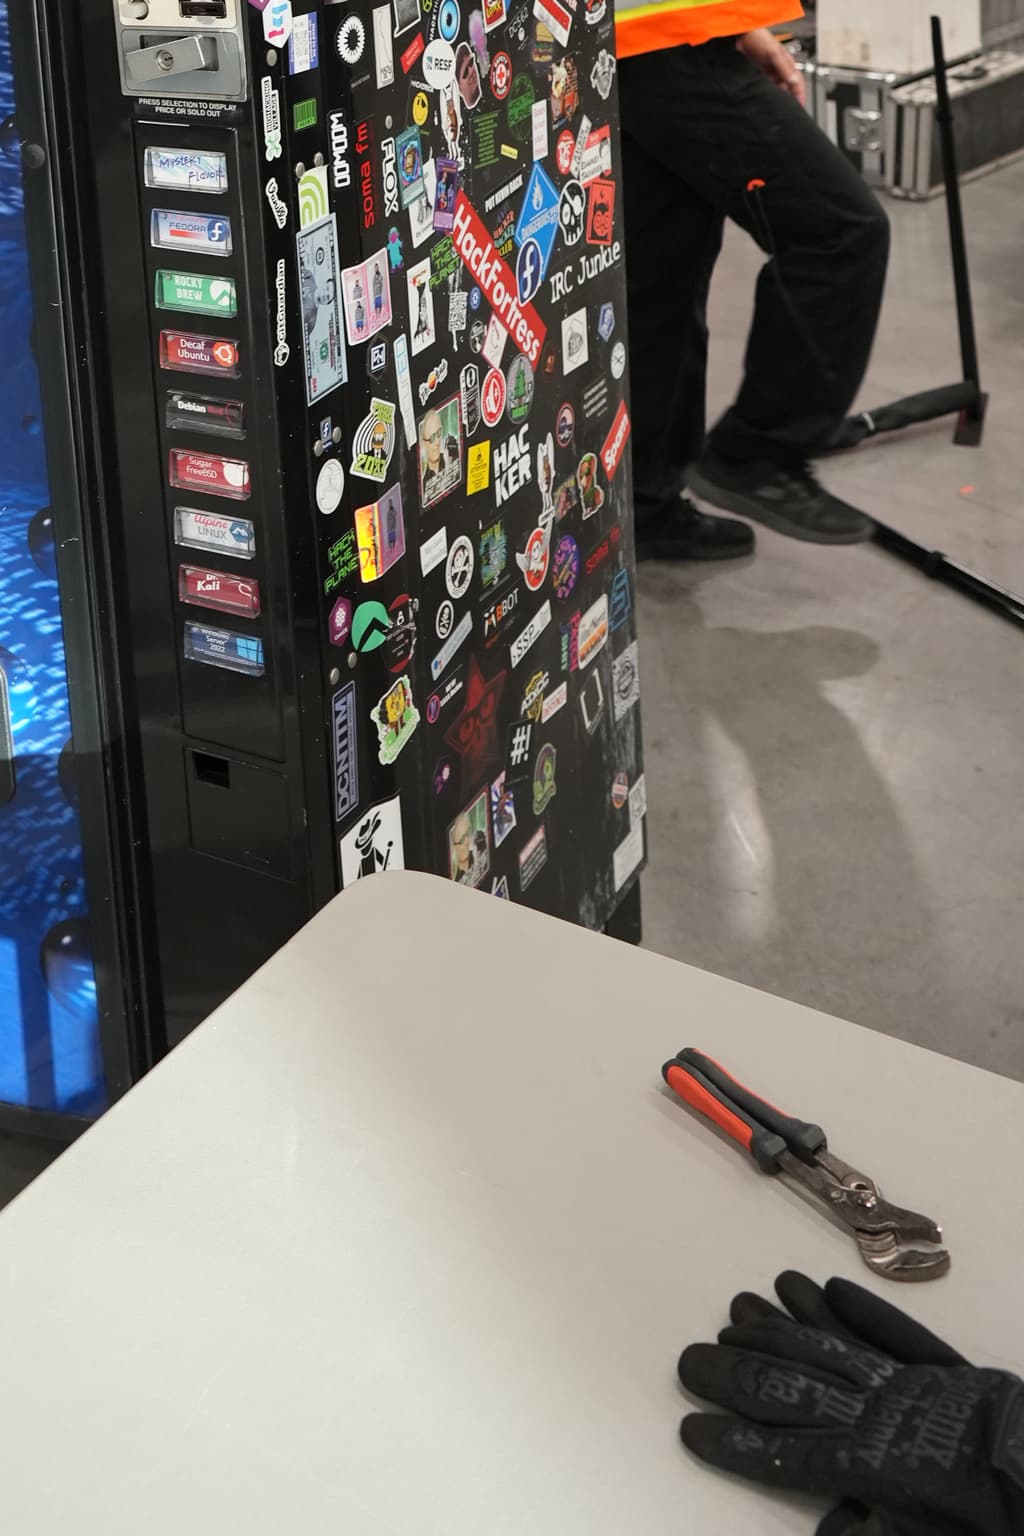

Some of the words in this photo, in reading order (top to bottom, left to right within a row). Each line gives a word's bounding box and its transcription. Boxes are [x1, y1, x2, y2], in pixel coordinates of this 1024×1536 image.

[429, 14, 438, 40] HACK
[138, 98, 161, 106] PRESS
[161, 99, 198, 109] SELECTION
[209, 102, 237, 111] DISPLAY
[155, 106, 175, 114] PRICE
[176, 107, 187, 115] OR
[187, 108, 206, 116] SOLD
[207, 109, 221, 117] OUT
[356, 123, 369, 154] fm
[360, 161, 374, 229] soma
[169, 222, 206, 233] FEDORA
[432, 237, 453, 259] HACK
[436, 250, 454, 267] THE
[429, 257, 460, 288] PLANET
[550, 266, 573, 304] IRC
[577, 241, 621, 286] Junkie
[175, 276, 203, 289] ROCKY
[453, 203, 540, 362] HackFortress
[176, 288, 203, 301] BREW
[277, 260, 285, 342] GitGuardian
[180, 338, 205, 350] Decaf
[177, 349, 211, 362] Ubuntu
[177, 401, 206, 413] Debian
[494, 423, 530, 477] HAC
[188, 456, 212, 468] Sugar
[495, 453, 532, 508] KER
[198, 526, 227, 540] LINUX
[329, 529, 356, 560] HACK
[335, 550, 353, 568] THE
[206, 573, 218, 581] Dr.
[197, 580, 220, 591] Kali
[201, 629, 230, 639] Windows
[206, 636, 227, 645] Server
[209, 644, 226, 653] 2022
